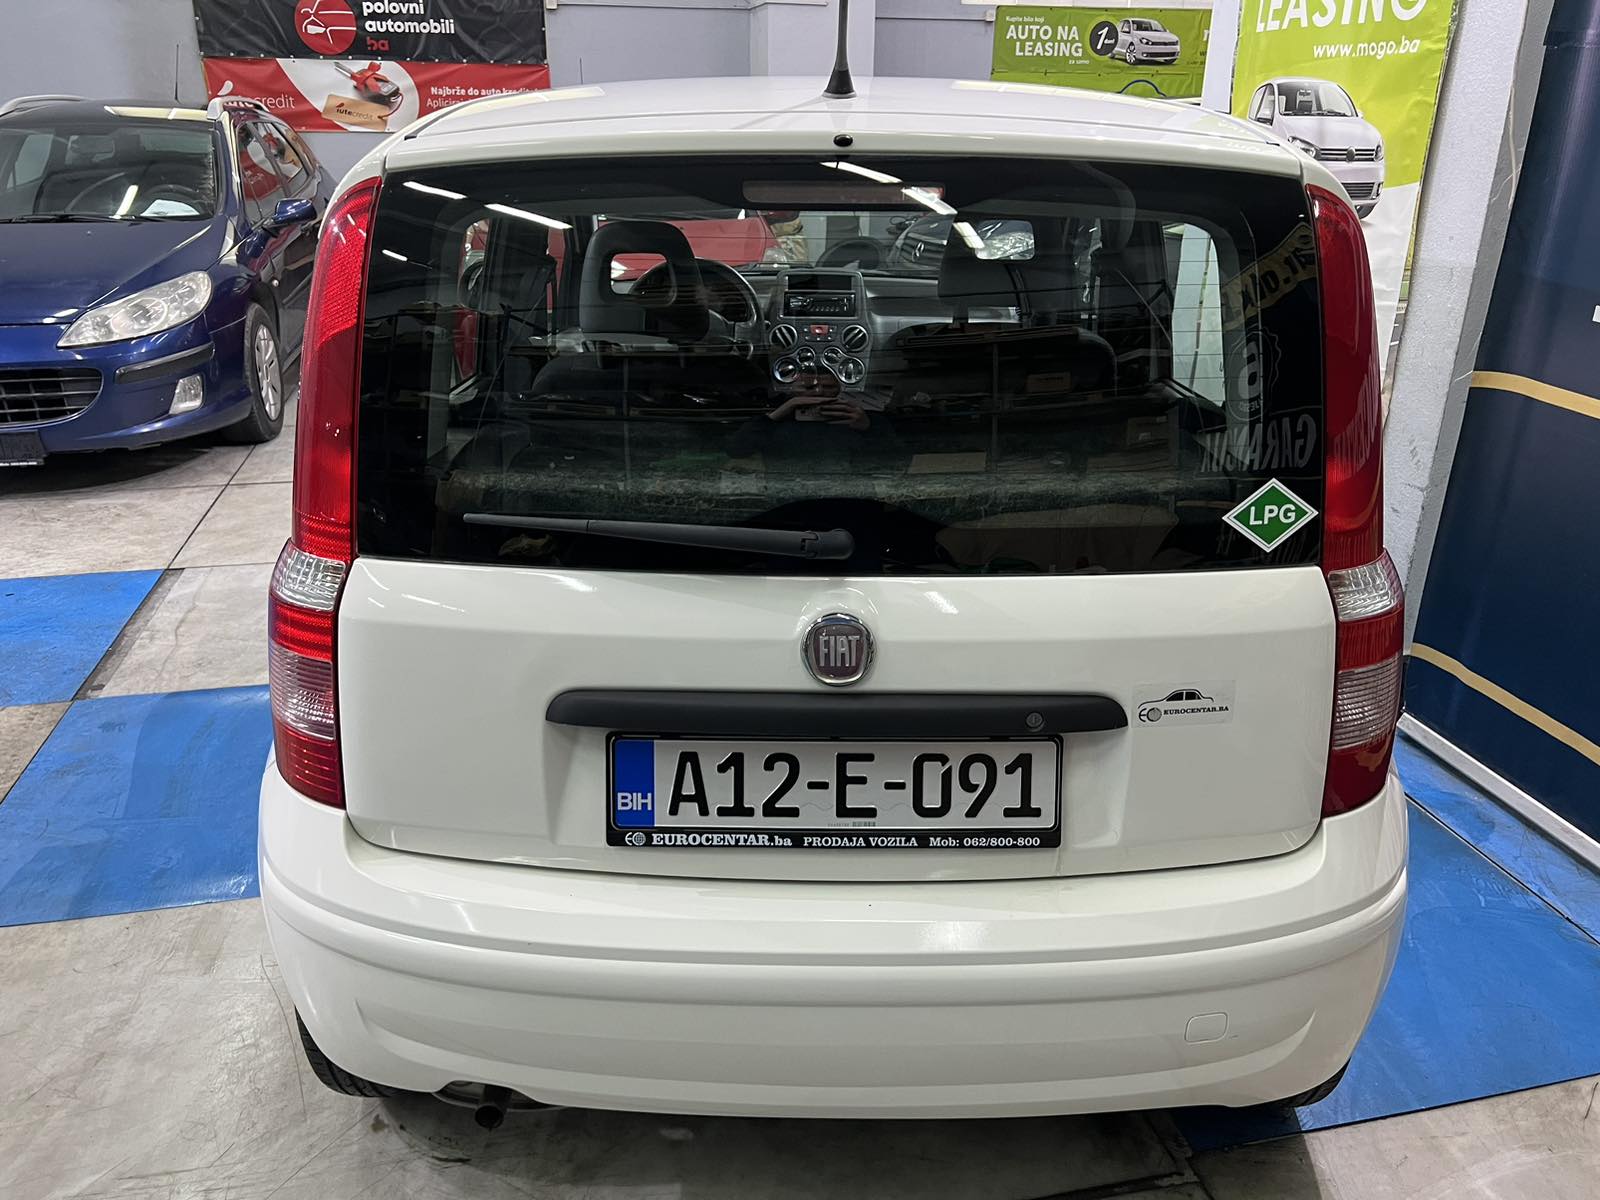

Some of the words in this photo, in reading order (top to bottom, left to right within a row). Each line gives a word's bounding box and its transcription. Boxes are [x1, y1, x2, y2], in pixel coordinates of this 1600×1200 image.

[362, 0, 425, 16] polovni
[365, 19, 455, 34] automobili
[1006, 25, 1052, 40] AUTO
[1057, 26, 1079, 40] NA
[1015, 41, 1083, 57] LEASING
[1313, 35, 1421, 60] www.mogo.ba
[431, 86, 465, 96] Najbrže
[467, 86, 479, 95] do
[1249, 503, 1297, 526] LPG
[819, 635, 860, 667] FIAT
[667, 750, 1043, 819] A12-E-091
[616, 792, 652, 811] BIH
[651, 833, 793, 847] EUROCENTAR.ba
[803, 837, 866, 847] PRODAJA
[869, 837, 918, 847] VOZILA
[929, 837, 960, 847] Mob:
[963, 837, 1041, 847] 062/800-800
